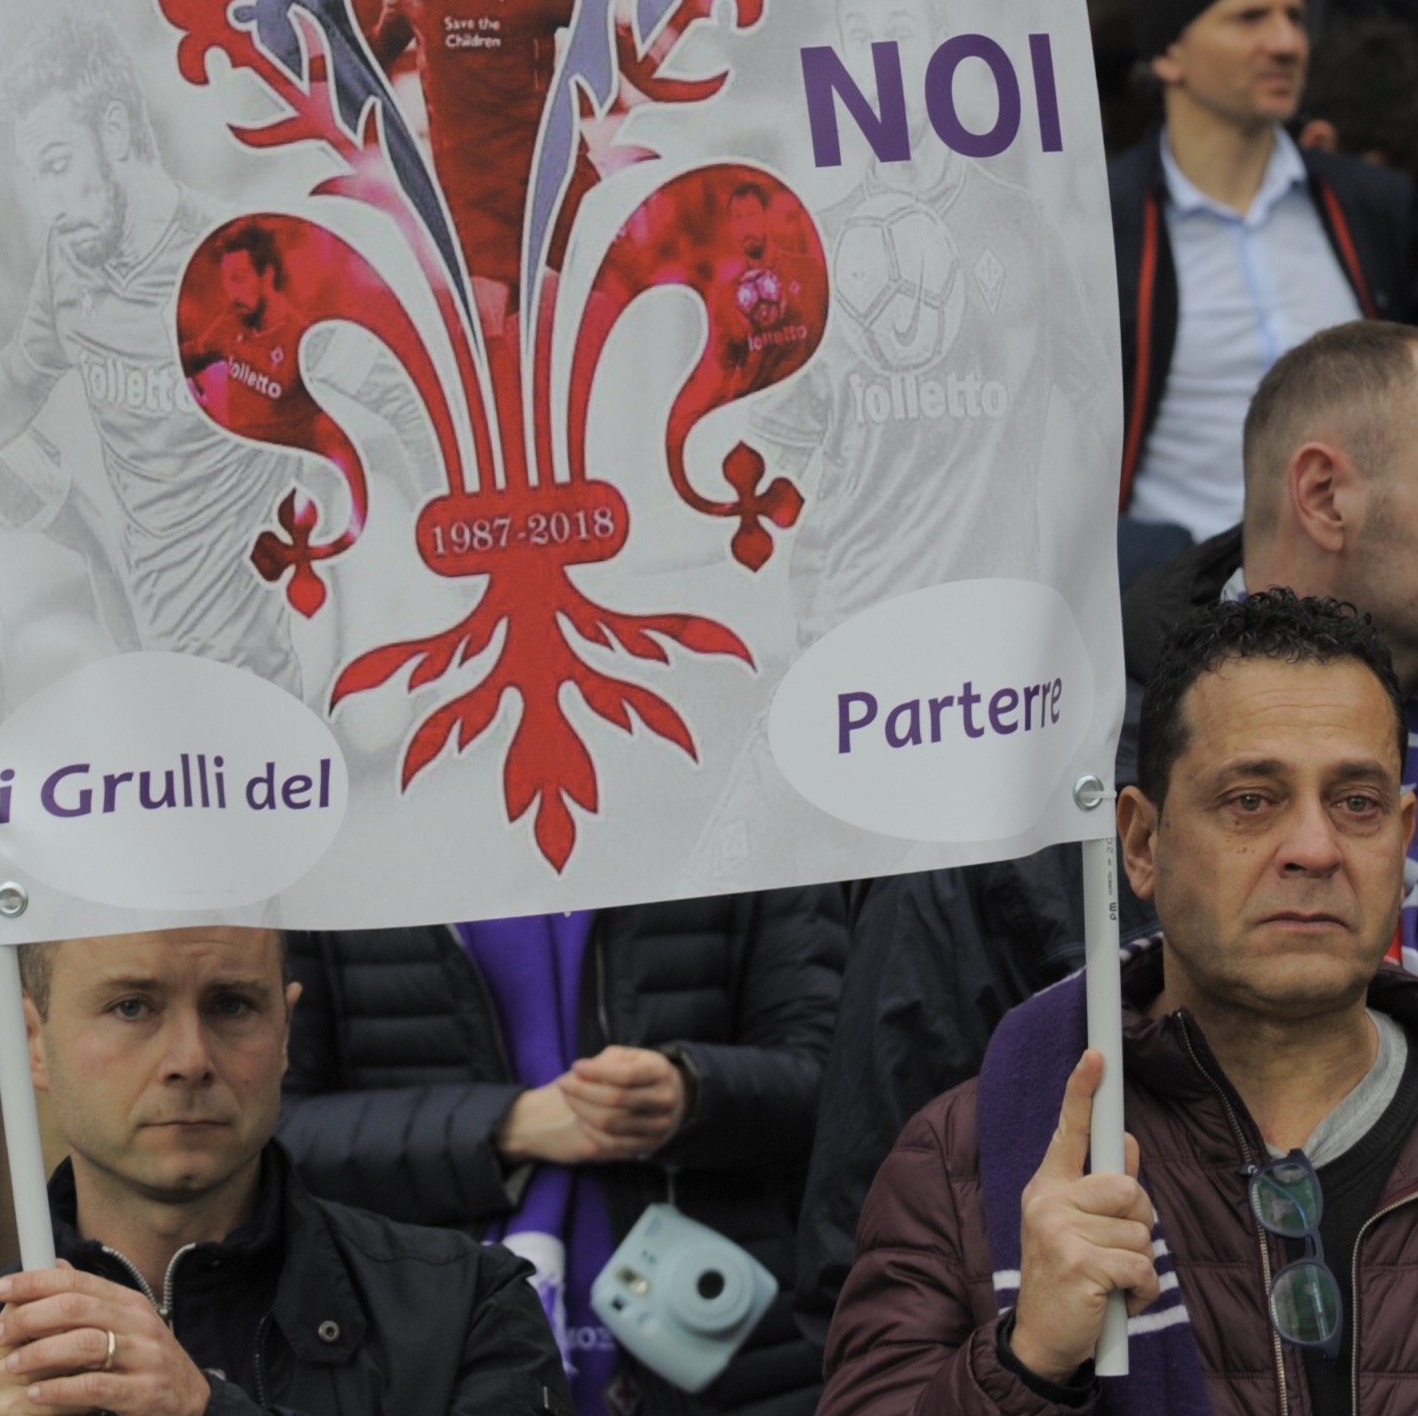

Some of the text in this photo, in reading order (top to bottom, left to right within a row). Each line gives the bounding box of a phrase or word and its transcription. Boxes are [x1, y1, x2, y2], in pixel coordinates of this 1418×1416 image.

[445, 33, 501, 48] Children
[799, 32, 1064, 169] NOI
[837, 676, 1063, 755] Parterre
[40, 753, 227, 819] Grulli
[245, 757, 332, 811] del
